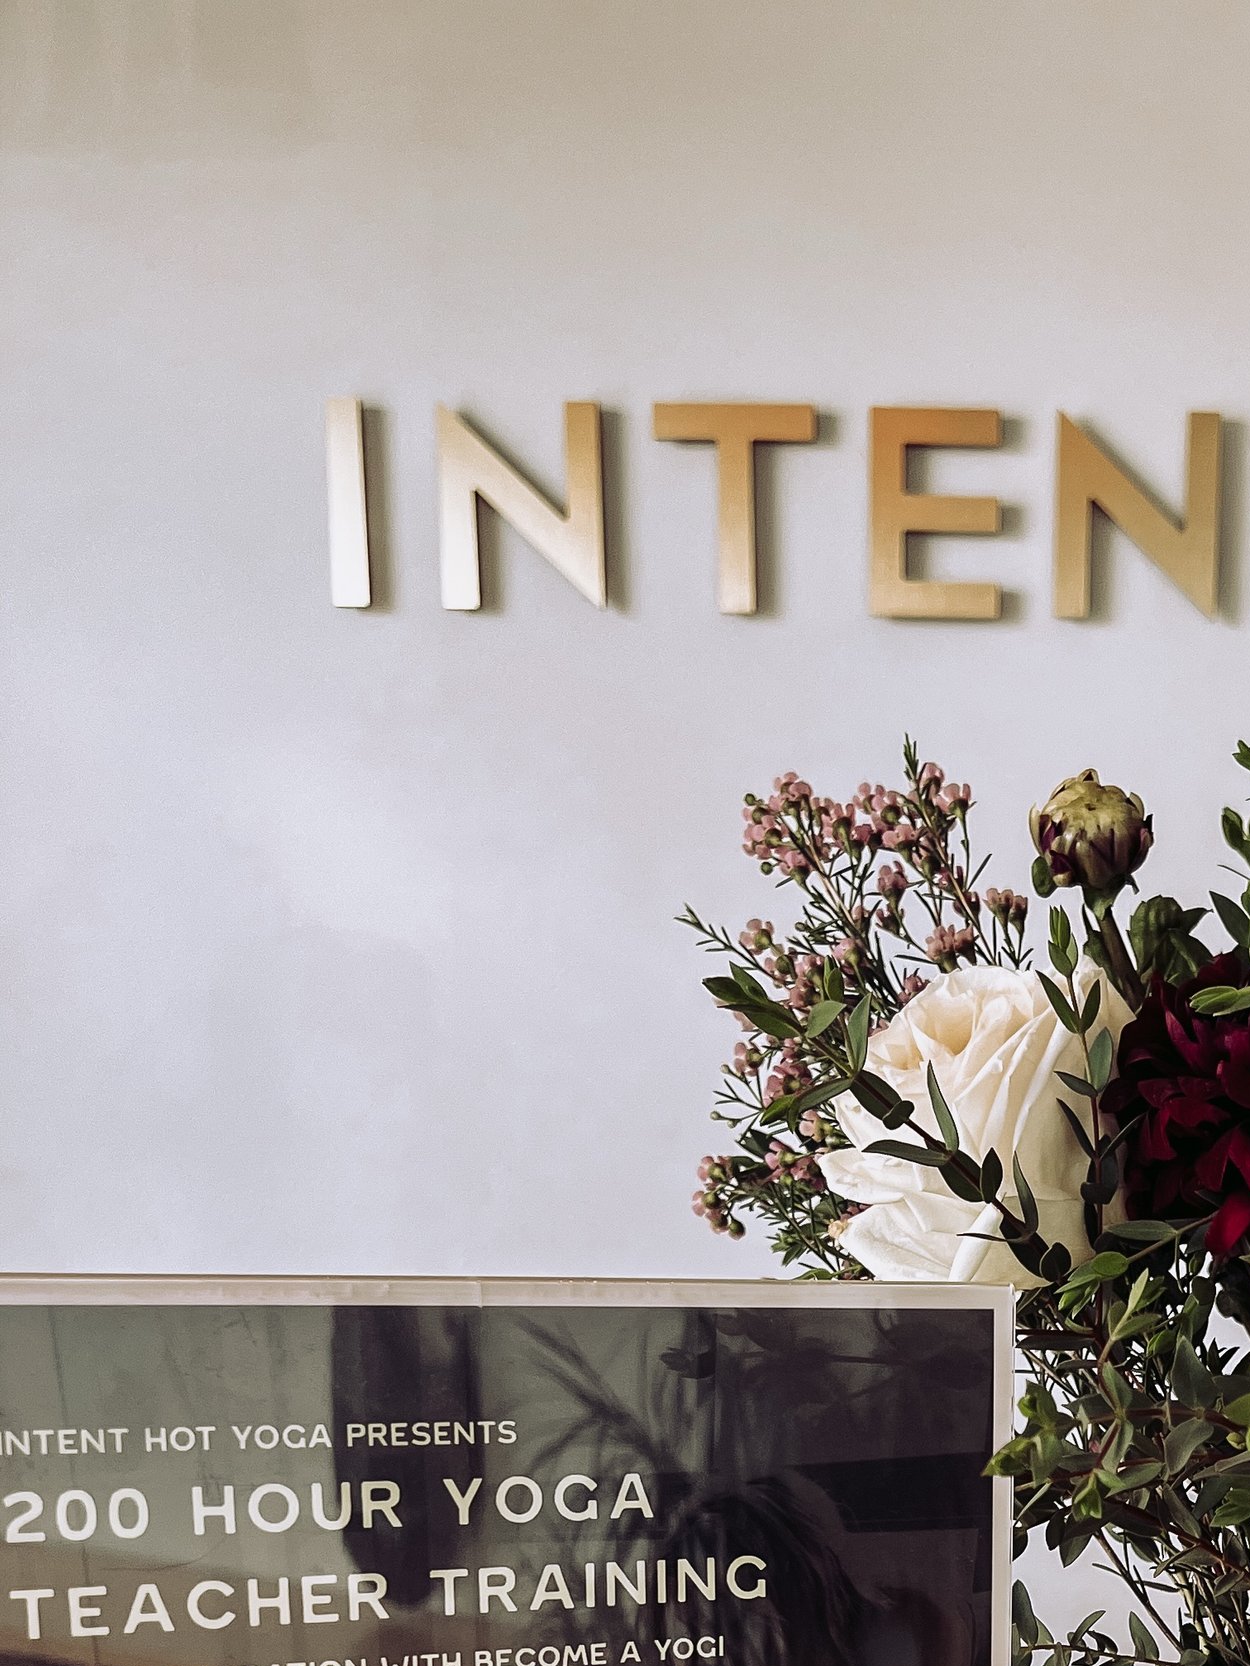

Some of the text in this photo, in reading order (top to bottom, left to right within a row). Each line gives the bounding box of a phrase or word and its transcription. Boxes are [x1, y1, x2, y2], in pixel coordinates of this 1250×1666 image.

[145, 1425, 216, 1453] HOT
[232, 1424, 333, 1450] YOGA
[346, 1420, 518, 1448] PRESENTS
[5, 1472, 655, 1544] 200 HOUR YOGA
[9, 1555, 767, 1640] TEACHER TRAINING
[620, 1641, 642, 1664] A
[654, 1635, 725, 1662] YOGI
